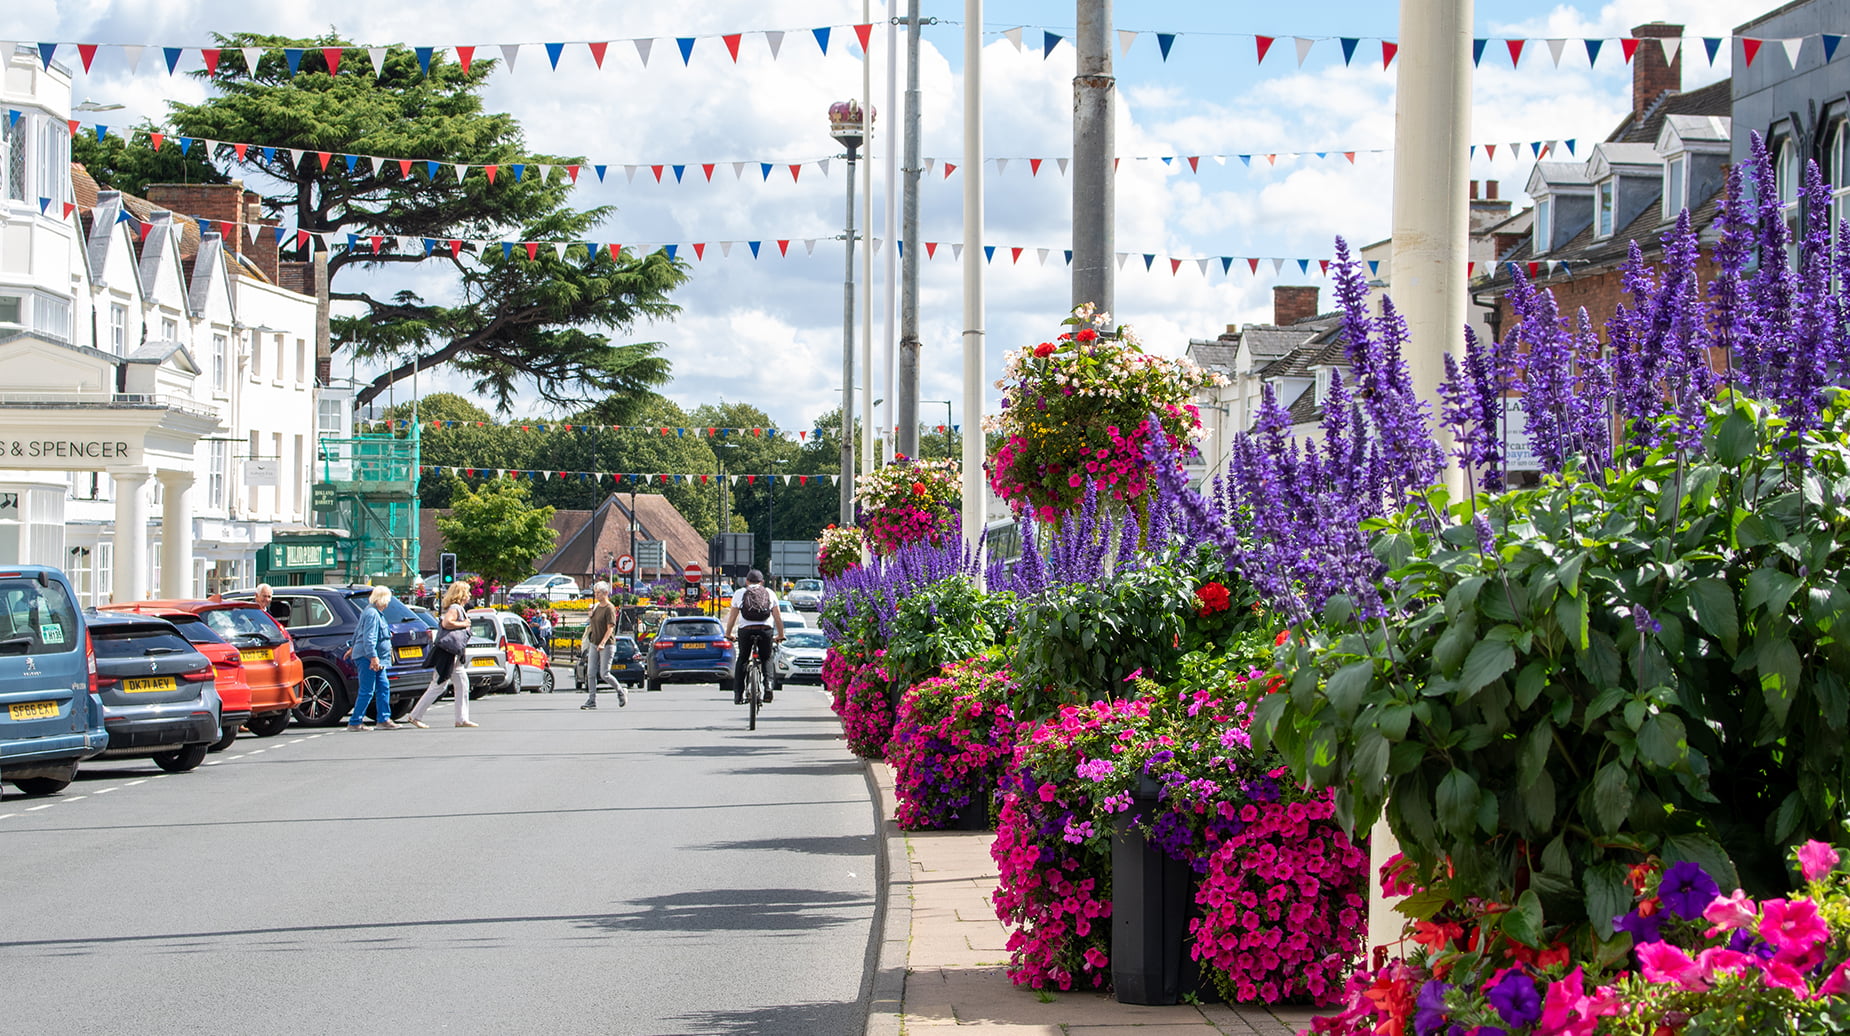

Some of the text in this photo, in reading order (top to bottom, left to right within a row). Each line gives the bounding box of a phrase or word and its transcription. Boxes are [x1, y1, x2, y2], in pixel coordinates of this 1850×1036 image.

[10, 441, 23, 457] &
[28, 441, 128, 458] SPENCER
[128, 680, 151, 690] DK71
[13, 702, 55, 717] SF66 EXT
